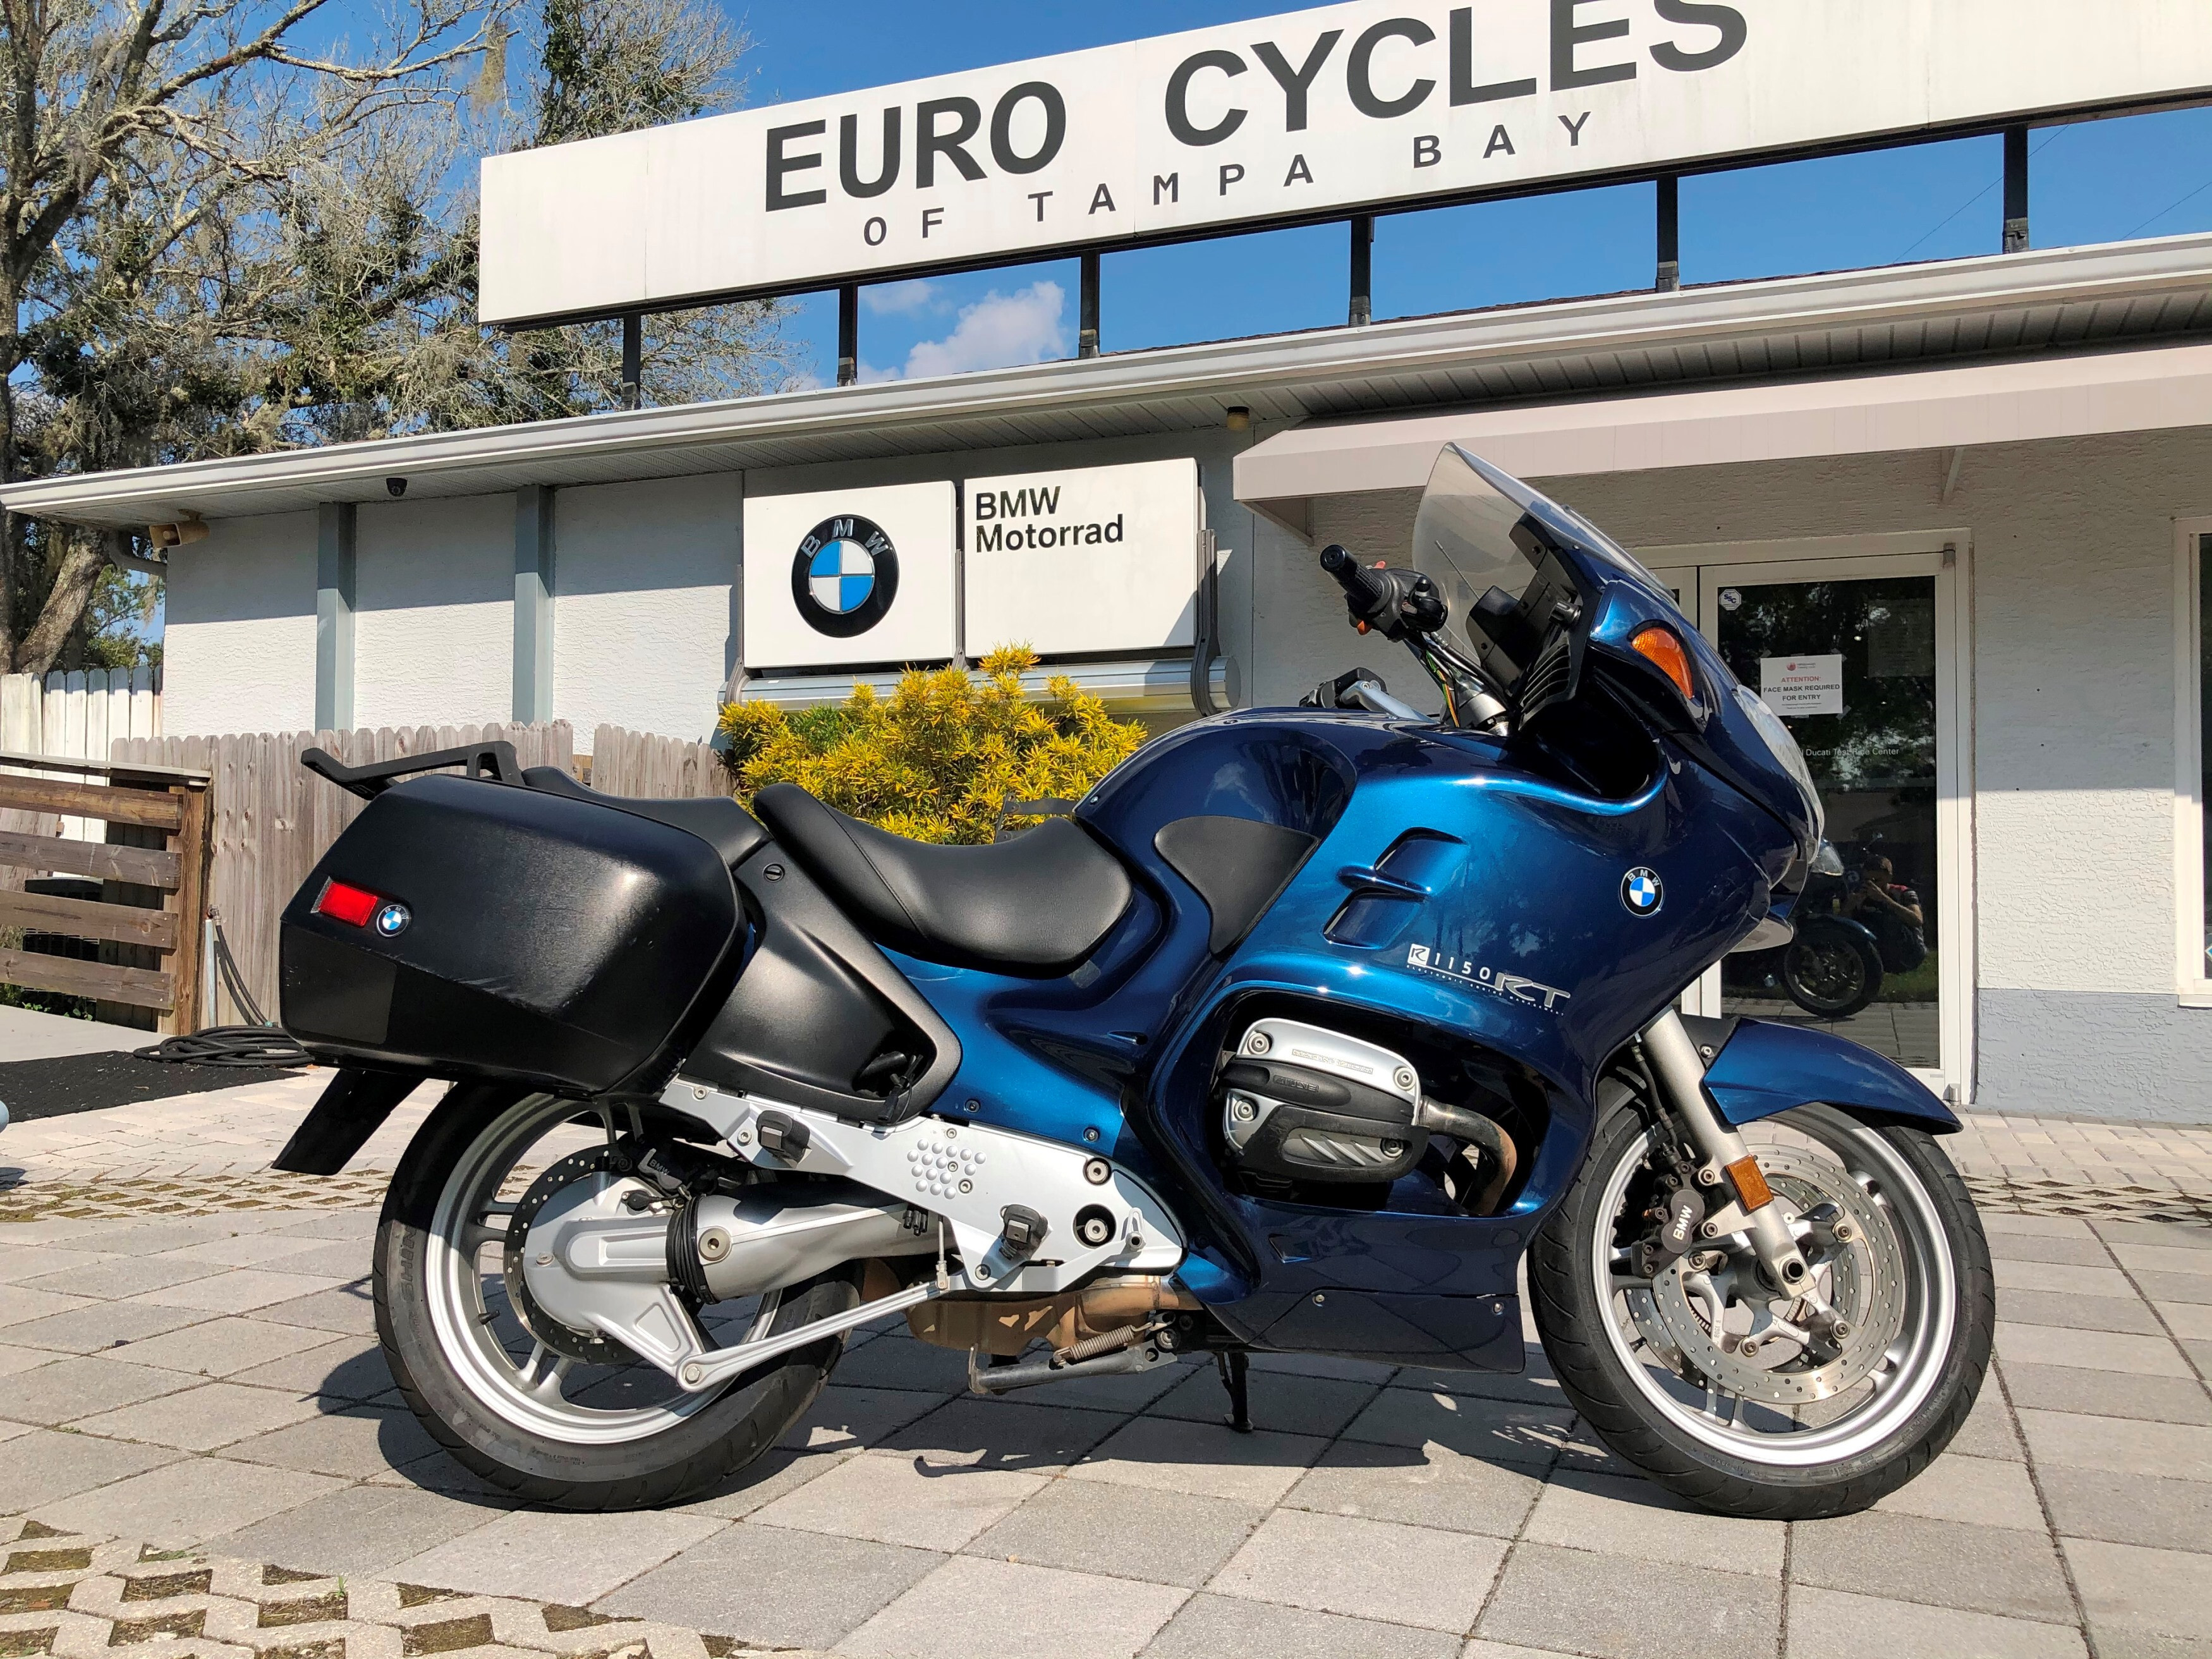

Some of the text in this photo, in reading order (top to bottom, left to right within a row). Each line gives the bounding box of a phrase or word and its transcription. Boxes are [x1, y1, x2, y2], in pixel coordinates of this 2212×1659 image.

[765, 0, 1747, 212] EURO CYCLES
[864, 111, 1591, 246] OF TAMPA BAY
[976, 485, 1061, 521] BMW
[800, 518, 889, 559] BMW
[976, 514, 1123, 553] Motorrad
[1806, 748, 1831, 757] Ducati
[1872, 748, 1899, 756] Center
[1627, 869, 1660, 887] BMW
[1434, 952, 1491, 980] 1150
[1494, 971, 1571, 1009] RT
[649, 1159, 670, 1175] BMW
[1672, 1205, 1692, 1241] BMW
